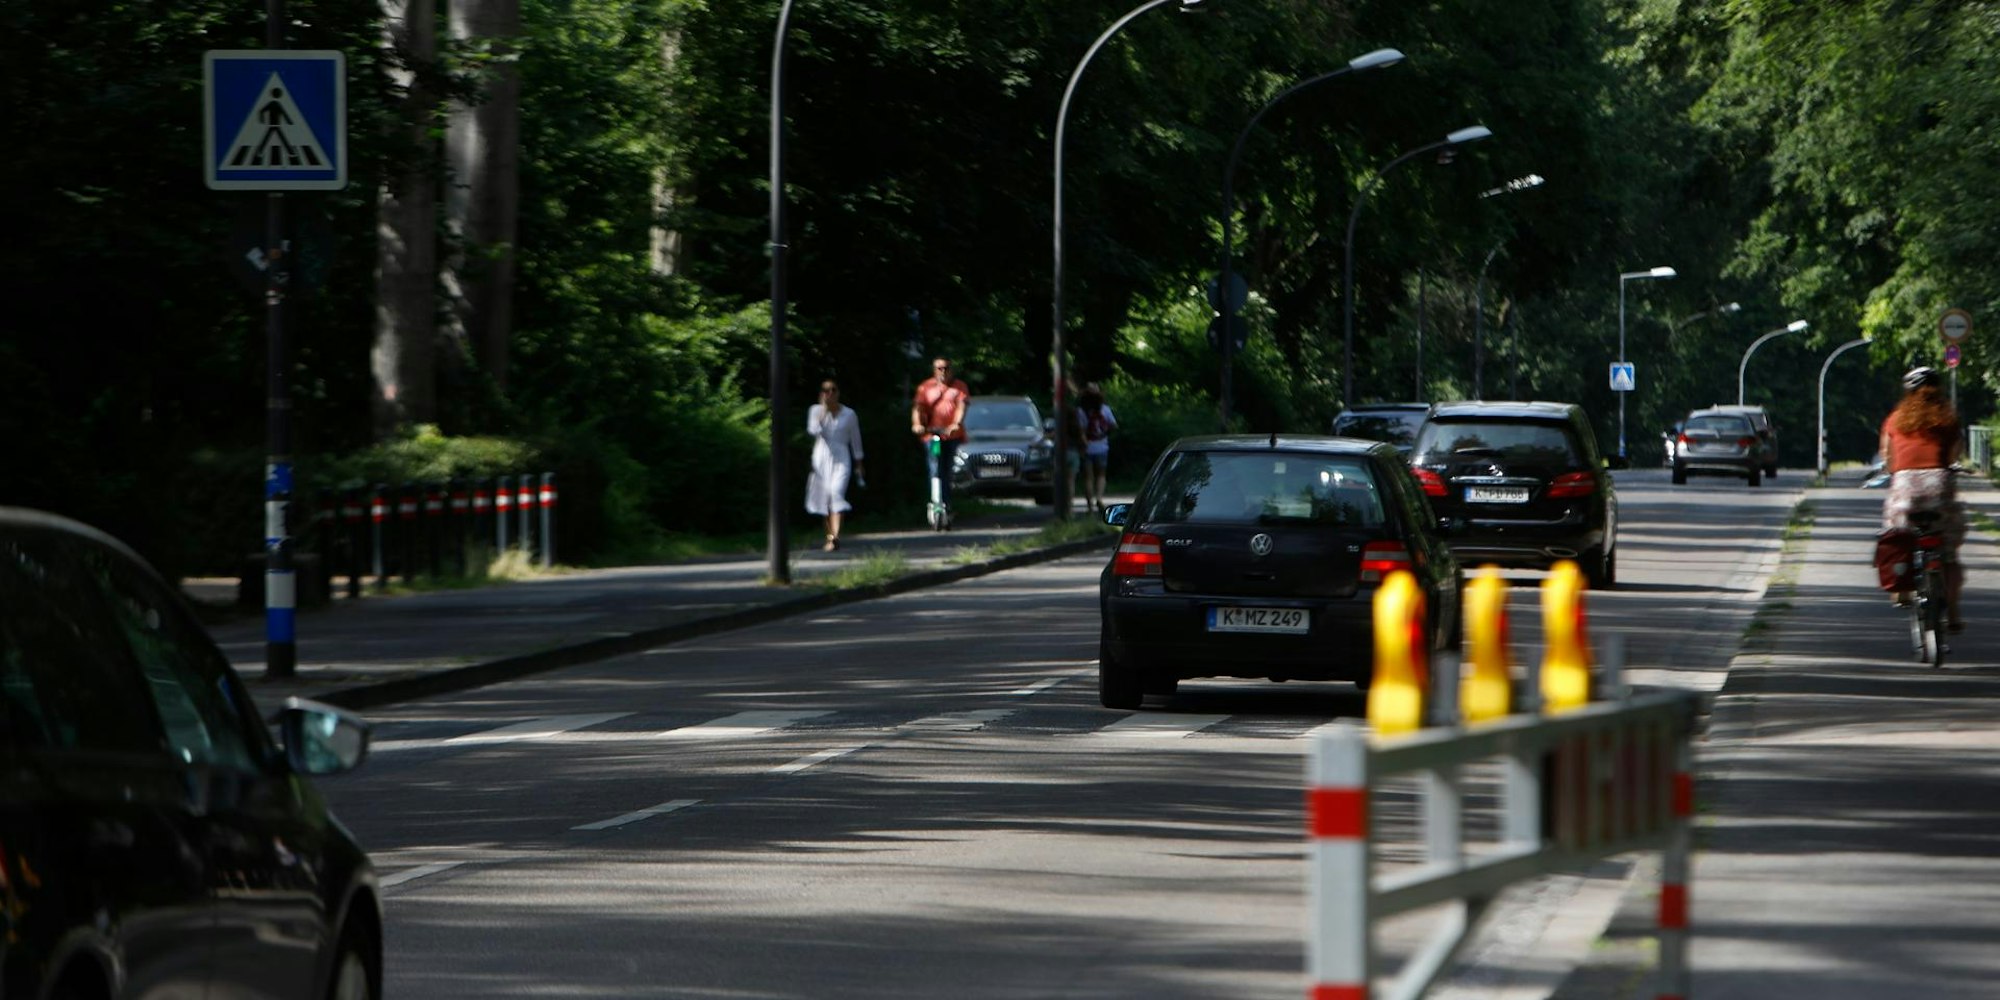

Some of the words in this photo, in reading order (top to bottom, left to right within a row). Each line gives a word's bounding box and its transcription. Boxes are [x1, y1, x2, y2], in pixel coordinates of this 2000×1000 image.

[1166, 538, 1193, 546] GOLF
[1223, 608, 1234, 626] K
[1245, 609, 1267, 626] MZ
[1271, 610, 1303, 627] 249
